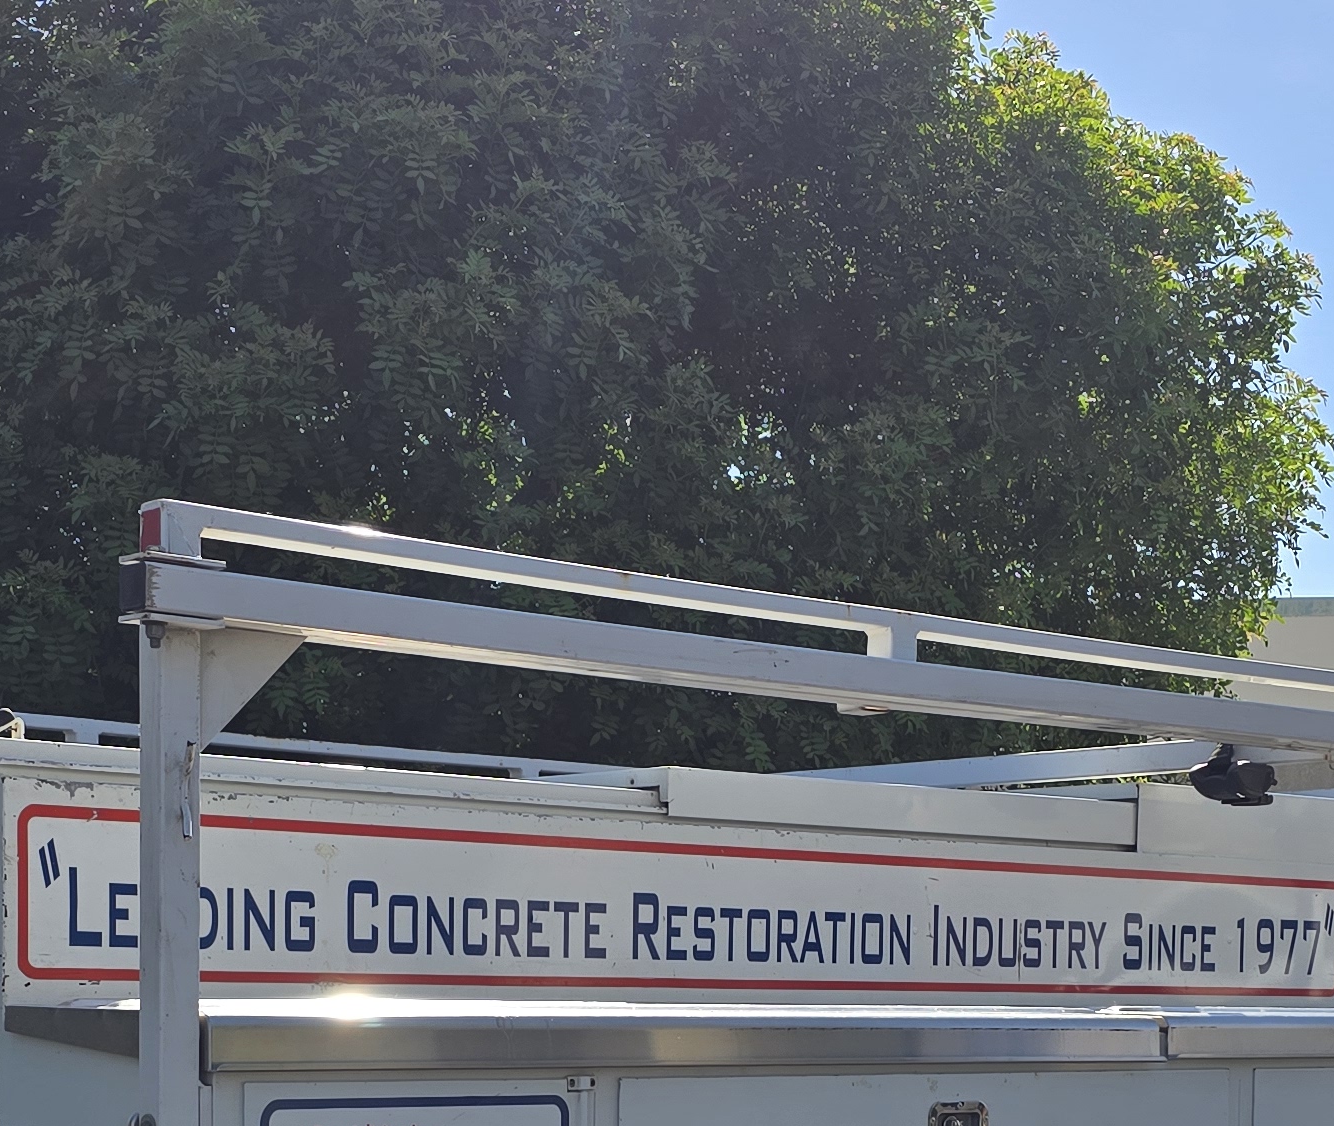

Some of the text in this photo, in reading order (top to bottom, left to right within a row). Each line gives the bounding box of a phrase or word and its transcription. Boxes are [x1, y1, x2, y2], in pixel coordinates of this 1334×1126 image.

[39, 838, 316, 952] "LEDING
[347, 880, 607, 960] CONCRETE
[632, 892, 912, 966] RESTORATION
[931, 905, 1108, 971] INDUSTRY
[1122, 913, 1216, 973] SINCE
